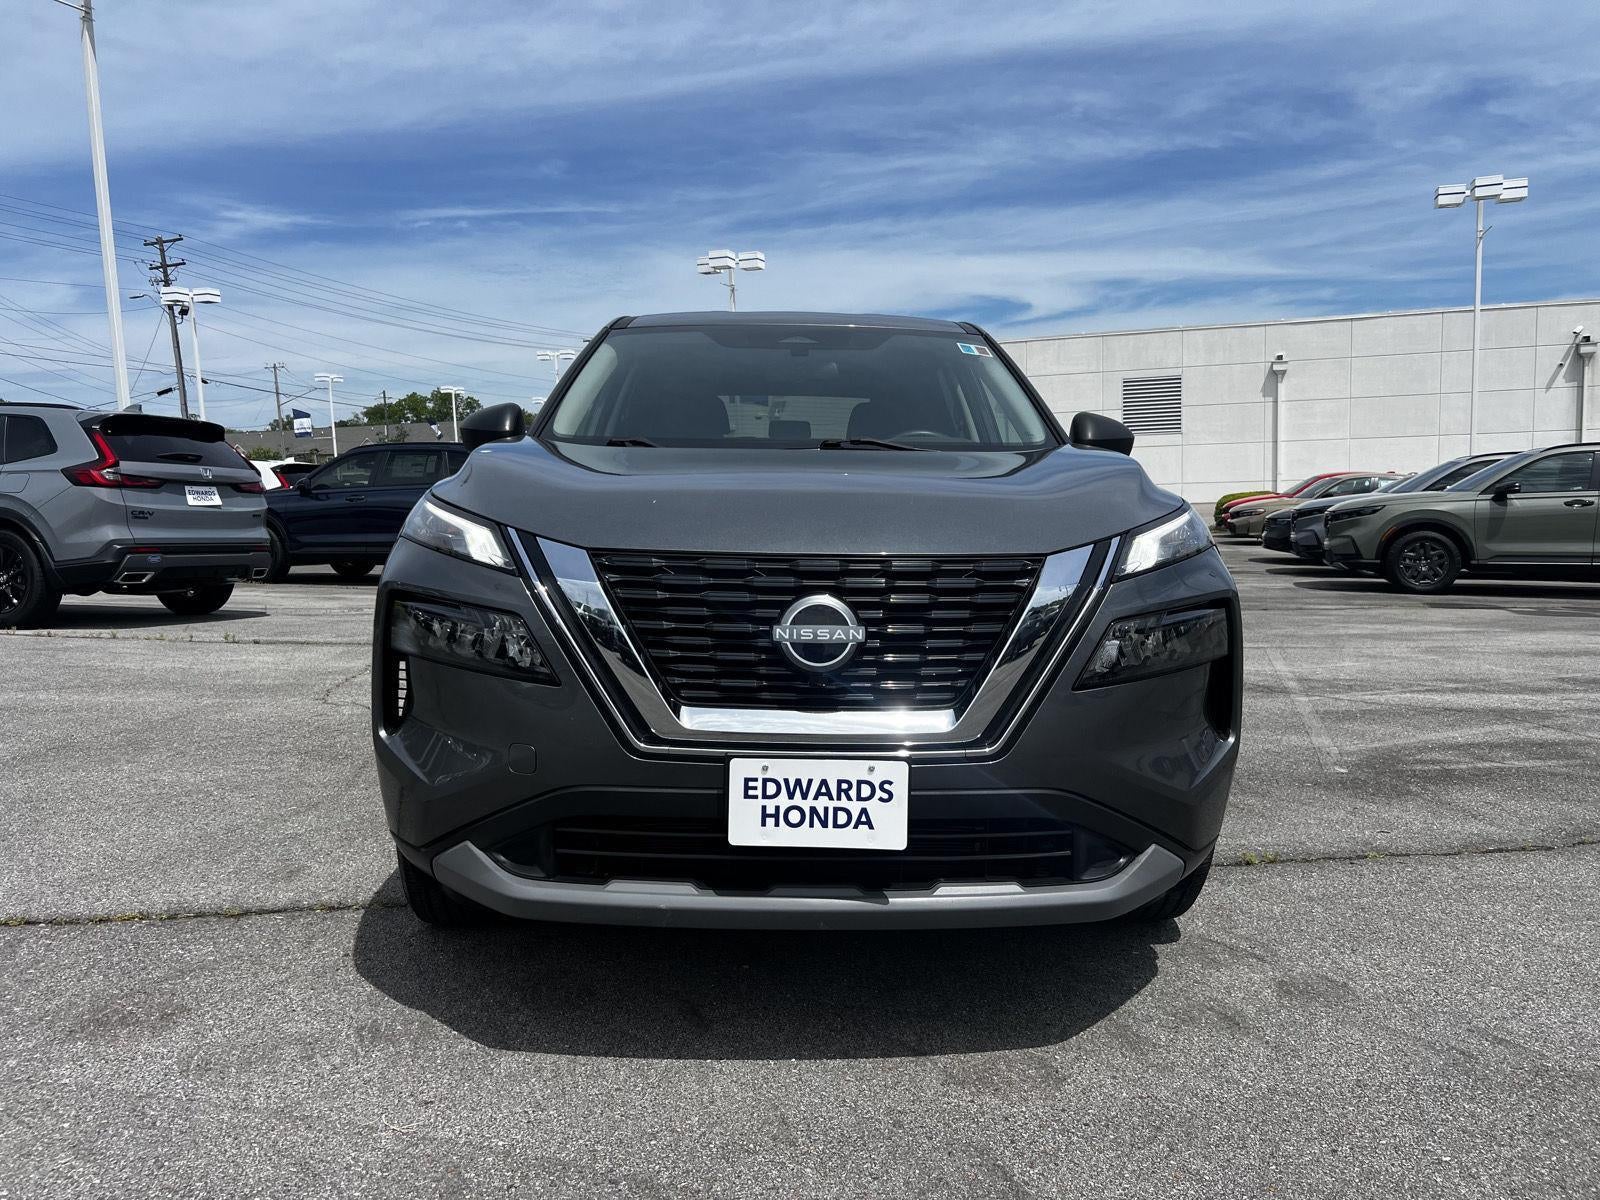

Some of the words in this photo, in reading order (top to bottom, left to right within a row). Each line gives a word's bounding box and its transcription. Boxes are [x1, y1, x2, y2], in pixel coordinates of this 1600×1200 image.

[775, 628, 863, 640] NISSAN
[743, 777, 894, 803] EDWARDS
[760, 805, 875, 830] HONDA
